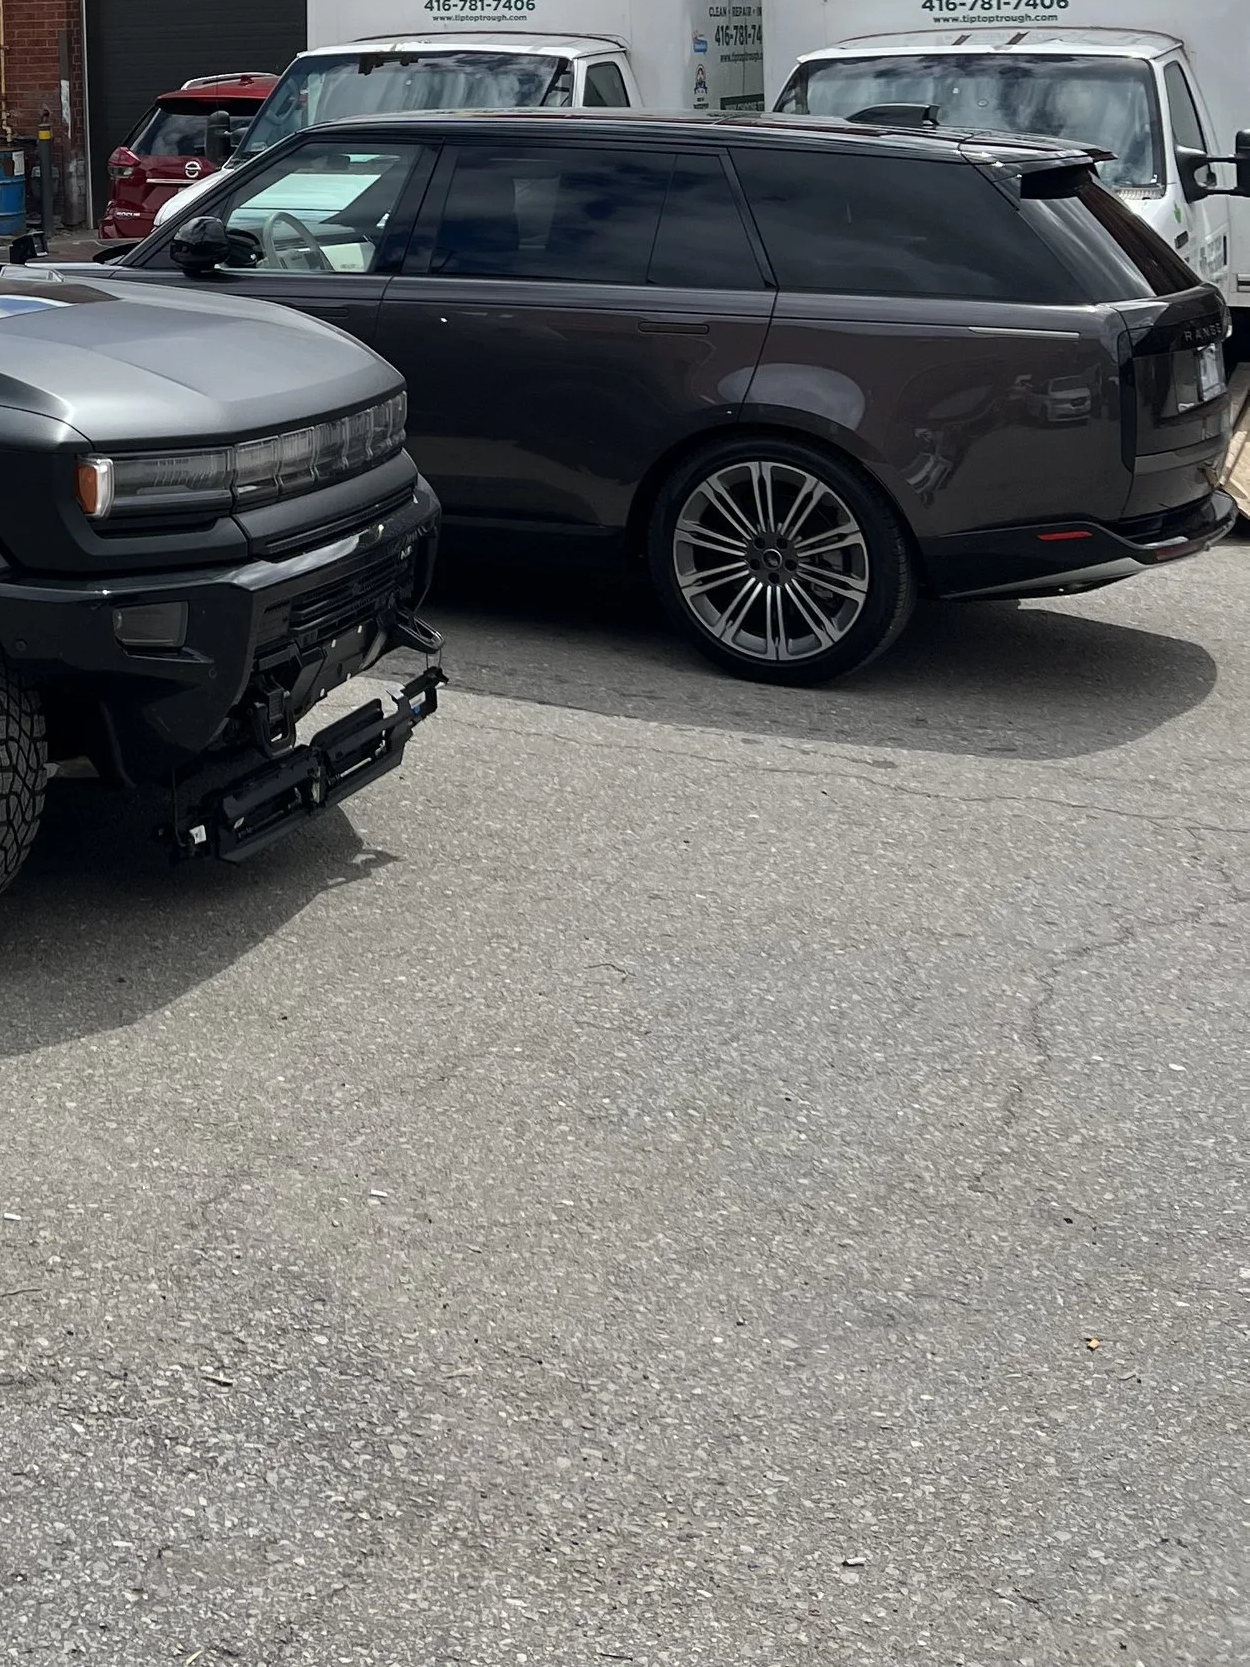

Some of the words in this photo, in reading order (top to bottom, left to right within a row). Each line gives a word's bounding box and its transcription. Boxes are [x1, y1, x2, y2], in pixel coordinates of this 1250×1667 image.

[432, 14, 527, 22] www.tiptoptrough.com
[709, 6, 727, 18] CLEAN
[732, 6, 751, 18] REPAIR
[933, 13, 1058, 23] www.tiptoptrough.com
[714, 24, 762, 46] 416-781-74
[1183, 322, 1222, 342] RANGE
